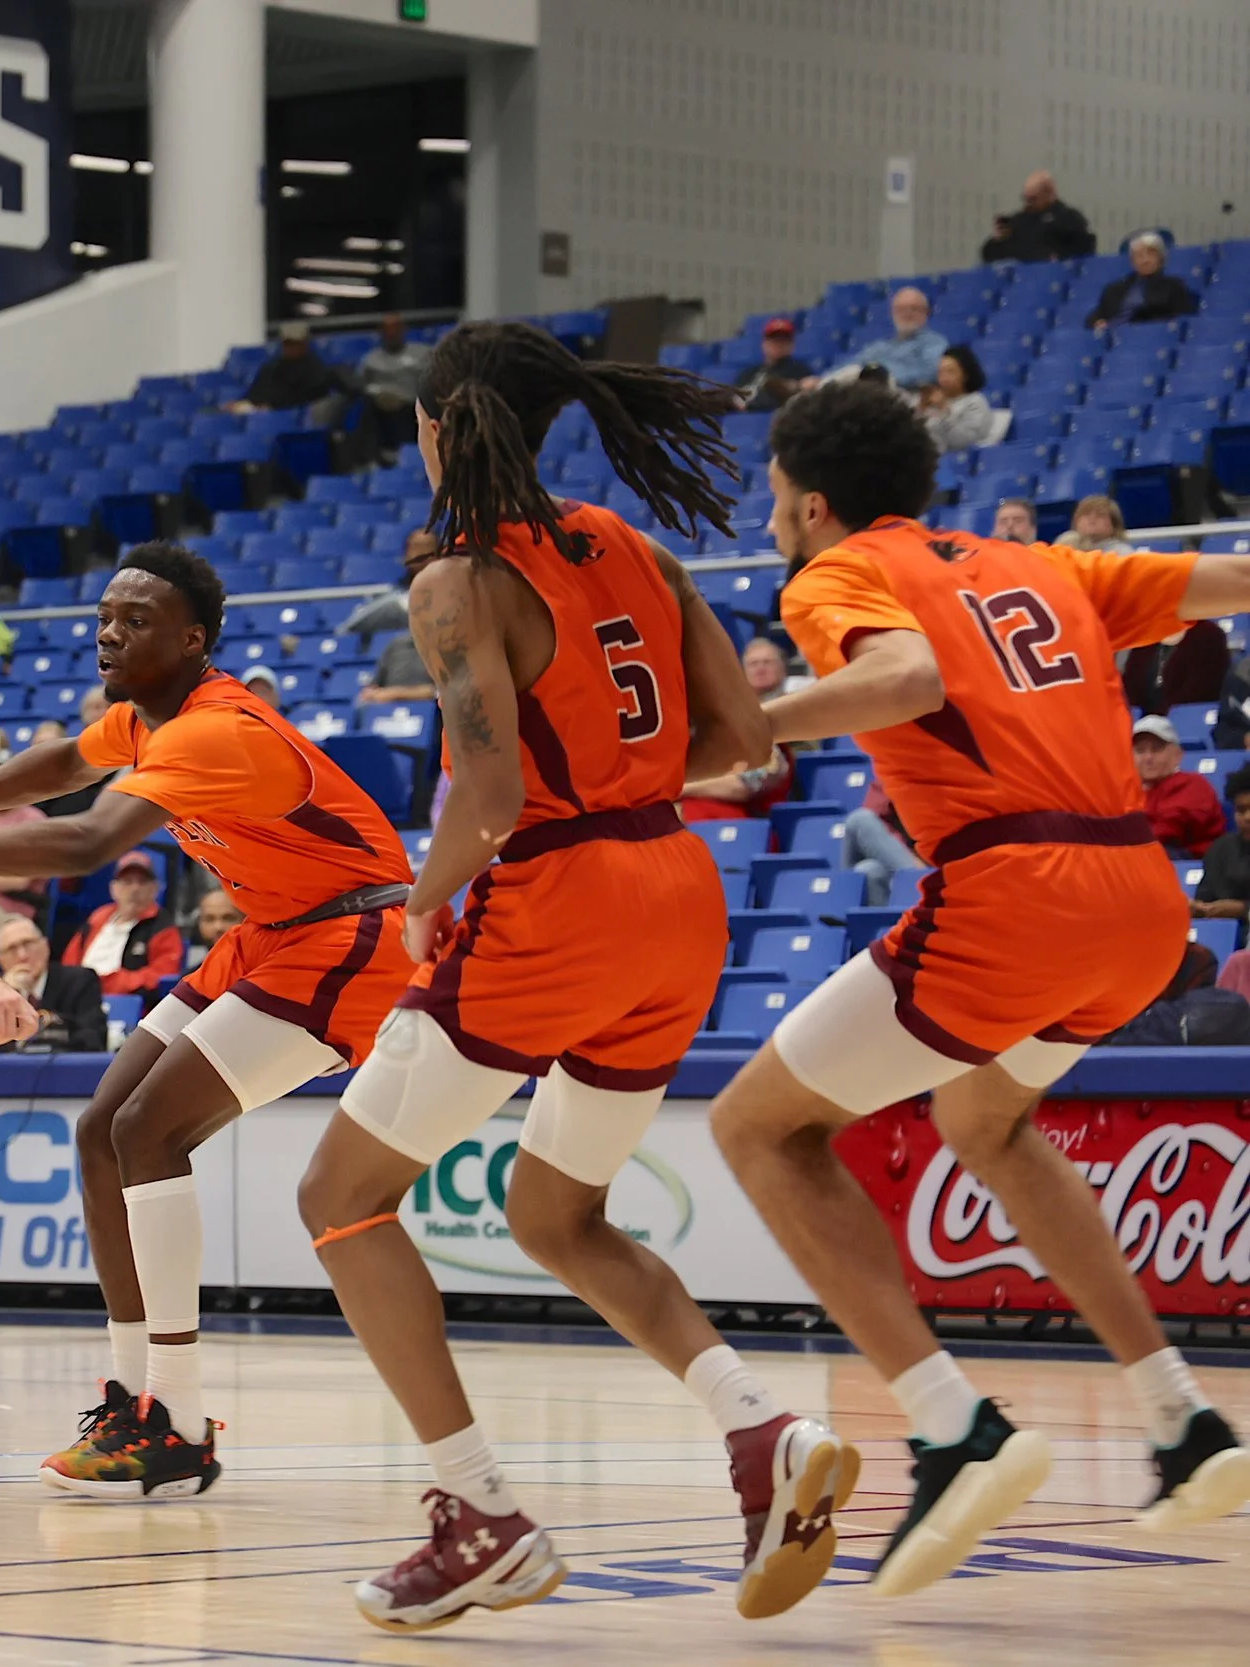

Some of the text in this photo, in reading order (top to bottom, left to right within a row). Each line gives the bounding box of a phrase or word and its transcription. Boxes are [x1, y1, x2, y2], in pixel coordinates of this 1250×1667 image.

[592, 614, 663, 743] 5
[956, 587, 1085, 693] 12
[424, 1220, 478, 1238] Health
